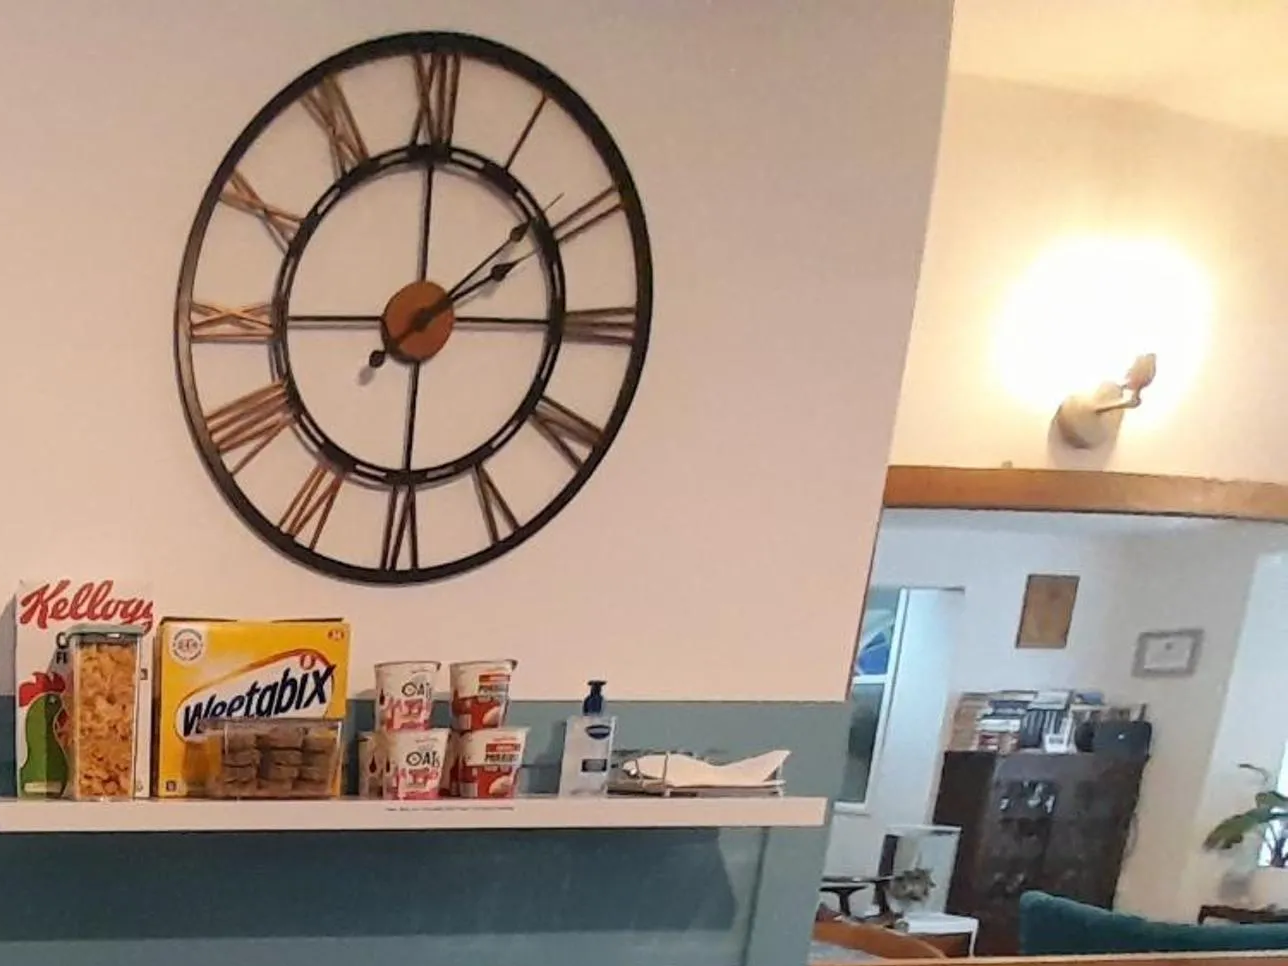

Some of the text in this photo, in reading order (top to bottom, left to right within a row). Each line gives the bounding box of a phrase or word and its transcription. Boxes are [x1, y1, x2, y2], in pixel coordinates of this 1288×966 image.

[301, 76, 370, 172] XI
[412, 52, 463, 146] XII
[190, 303, 273, 344] IX
[183, 664, 337, 737] Weetabix
